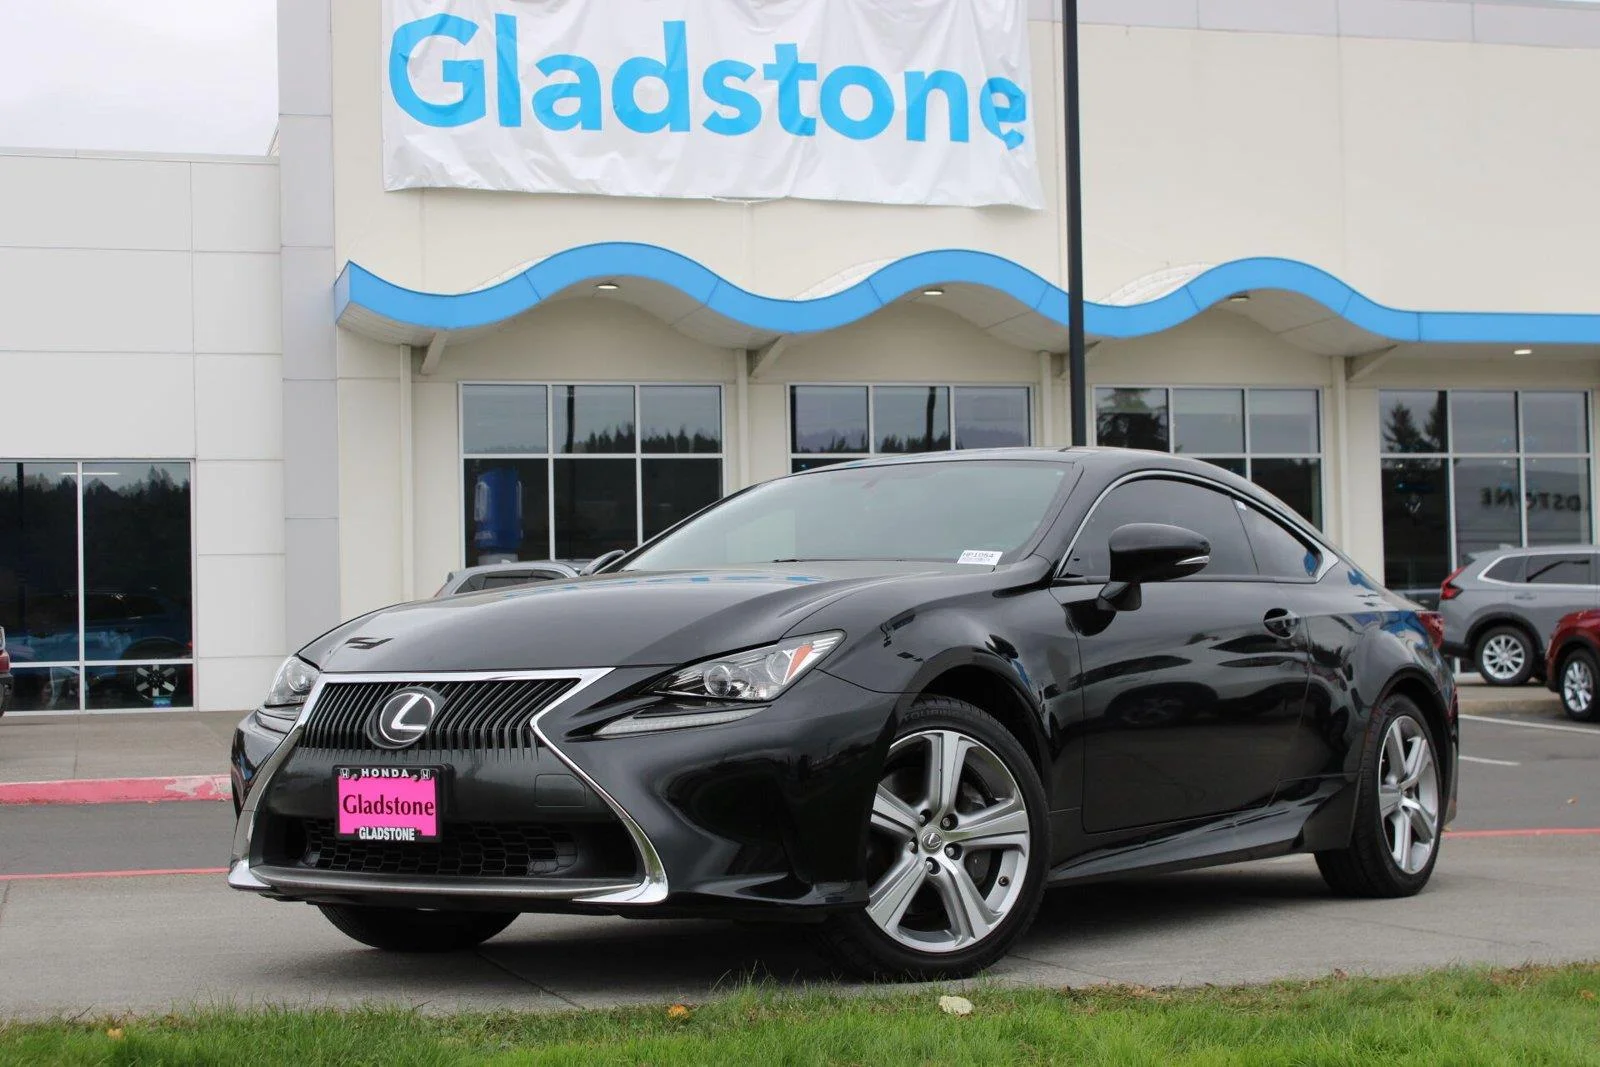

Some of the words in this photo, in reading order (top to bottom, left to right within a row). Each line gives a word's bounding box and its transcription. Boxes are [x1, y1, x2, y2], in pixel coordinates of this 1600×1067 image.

[388, 13, 1026, 150] Gladstone
[361, 768, 409, 778] HONDA
[342, 793, 435, 816] Gladstone
[359, 827, 415, 841] GLADSTONE
